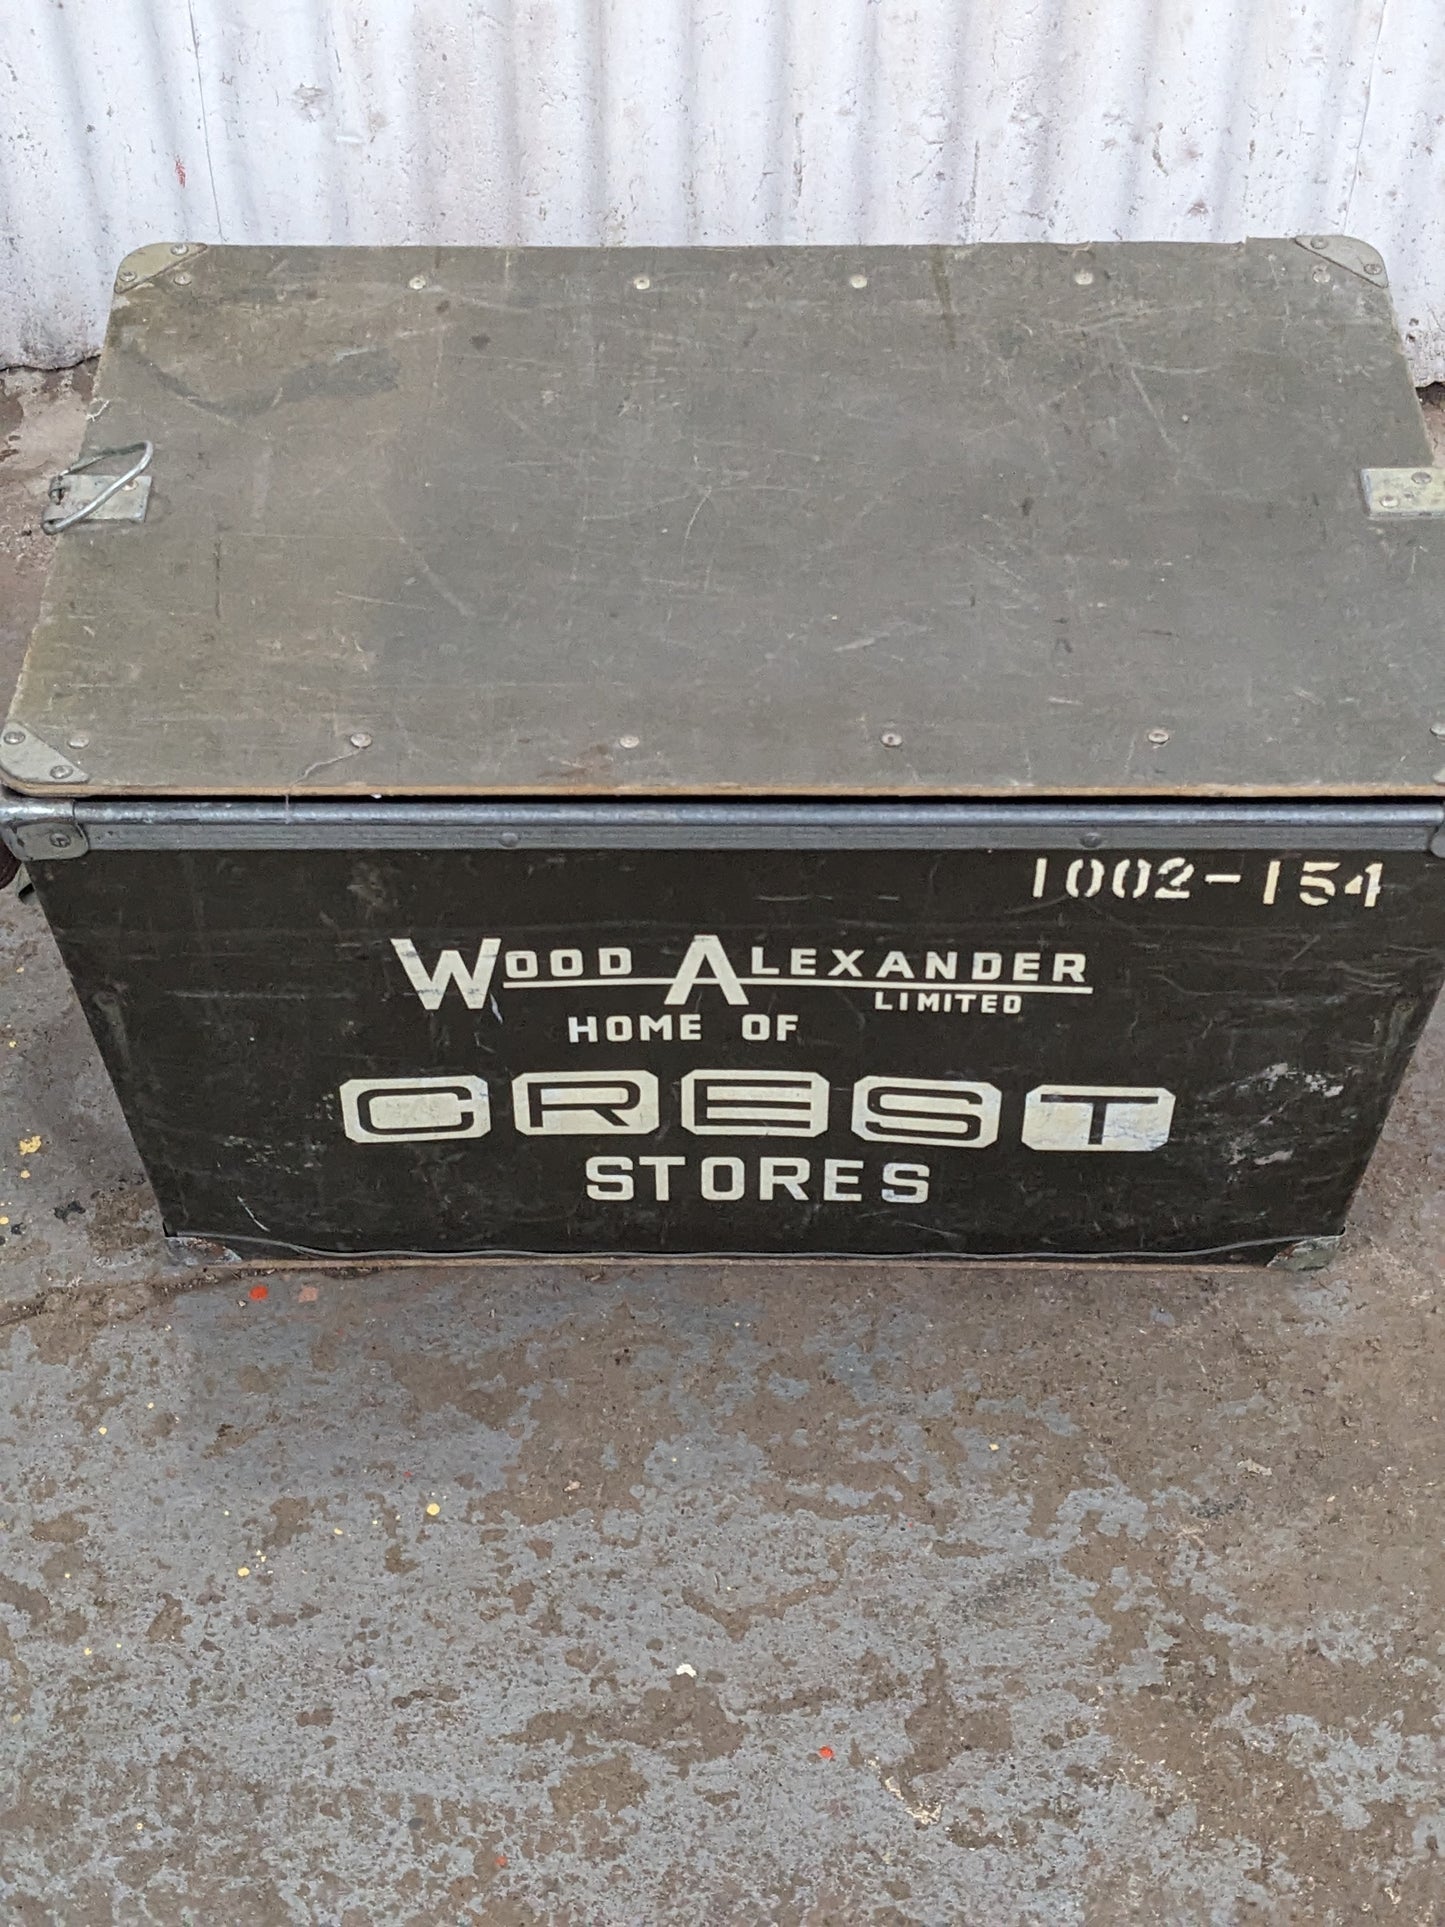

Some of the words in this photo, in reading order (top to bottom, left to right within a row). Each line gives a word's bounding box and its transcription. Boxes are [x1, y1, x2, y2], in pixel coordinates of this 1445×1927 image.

[1033, 856, 1384, 909] 1002-154
[390, 937, 633, 1010] WOOD
[664, 934, 1088, 1006] ALEXANDER
[874, 991, 1022, 1014] LIMITED
[568, 1014, 702, 1043] HOME
[741, 1013, 799, 1042] OF
[342, 1071, 1174, 1150] CREST
[586, 1156, 930, 1204] STORES
